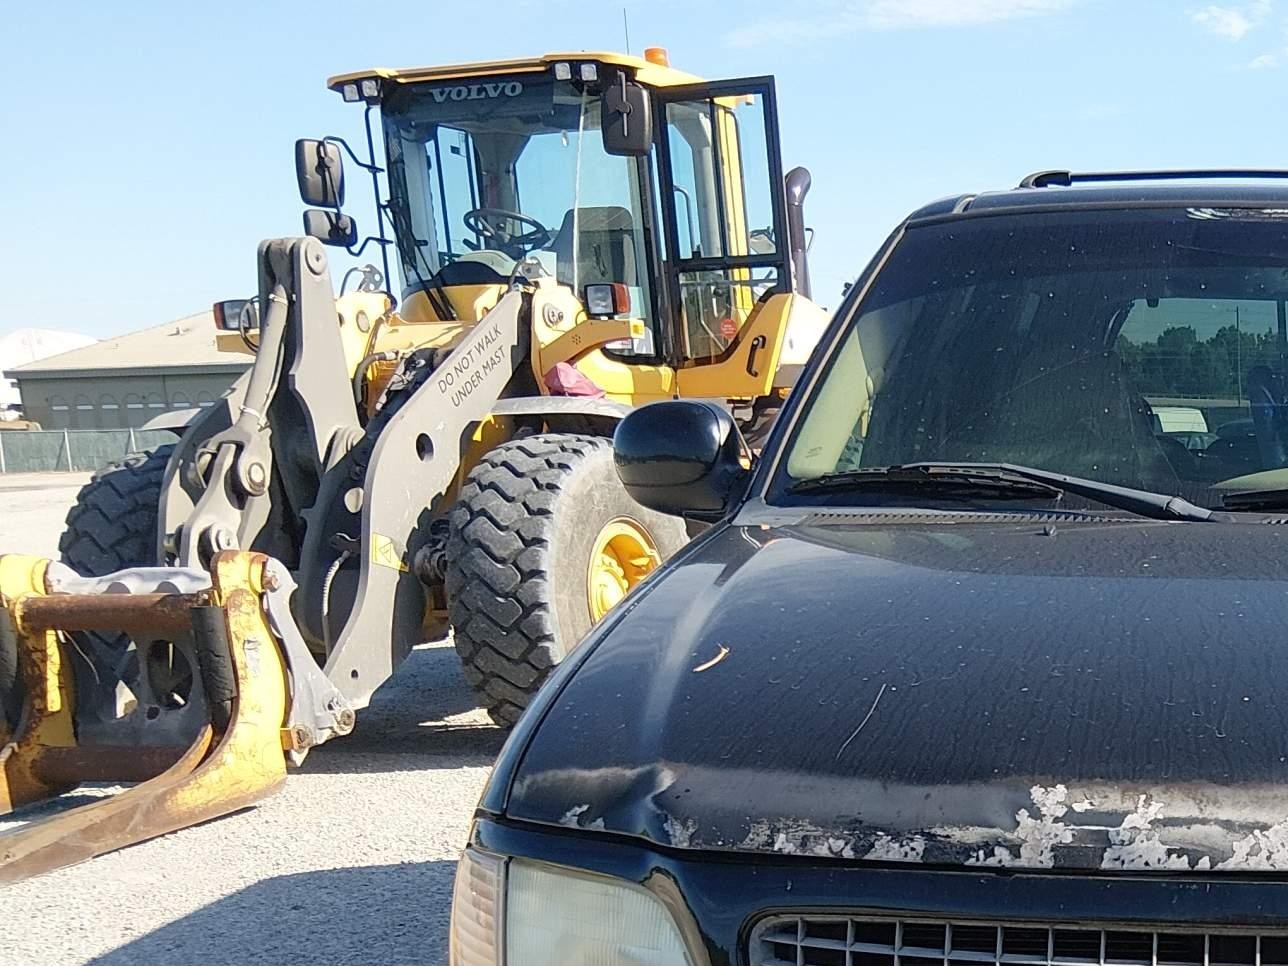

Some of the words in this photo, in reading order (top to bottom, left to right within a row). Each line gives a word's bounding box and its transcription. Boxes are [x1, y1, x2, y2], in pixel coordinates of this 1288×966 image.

[430, 82, 523, 103] VOLVO
[438, 372, 454, 394] DO
[453, 349, 475, 378] NOT
[473, 323, 502, 356] WALK
[451, 370, 484, 408] UNDER
[481, 345, 506, 376] MAST
